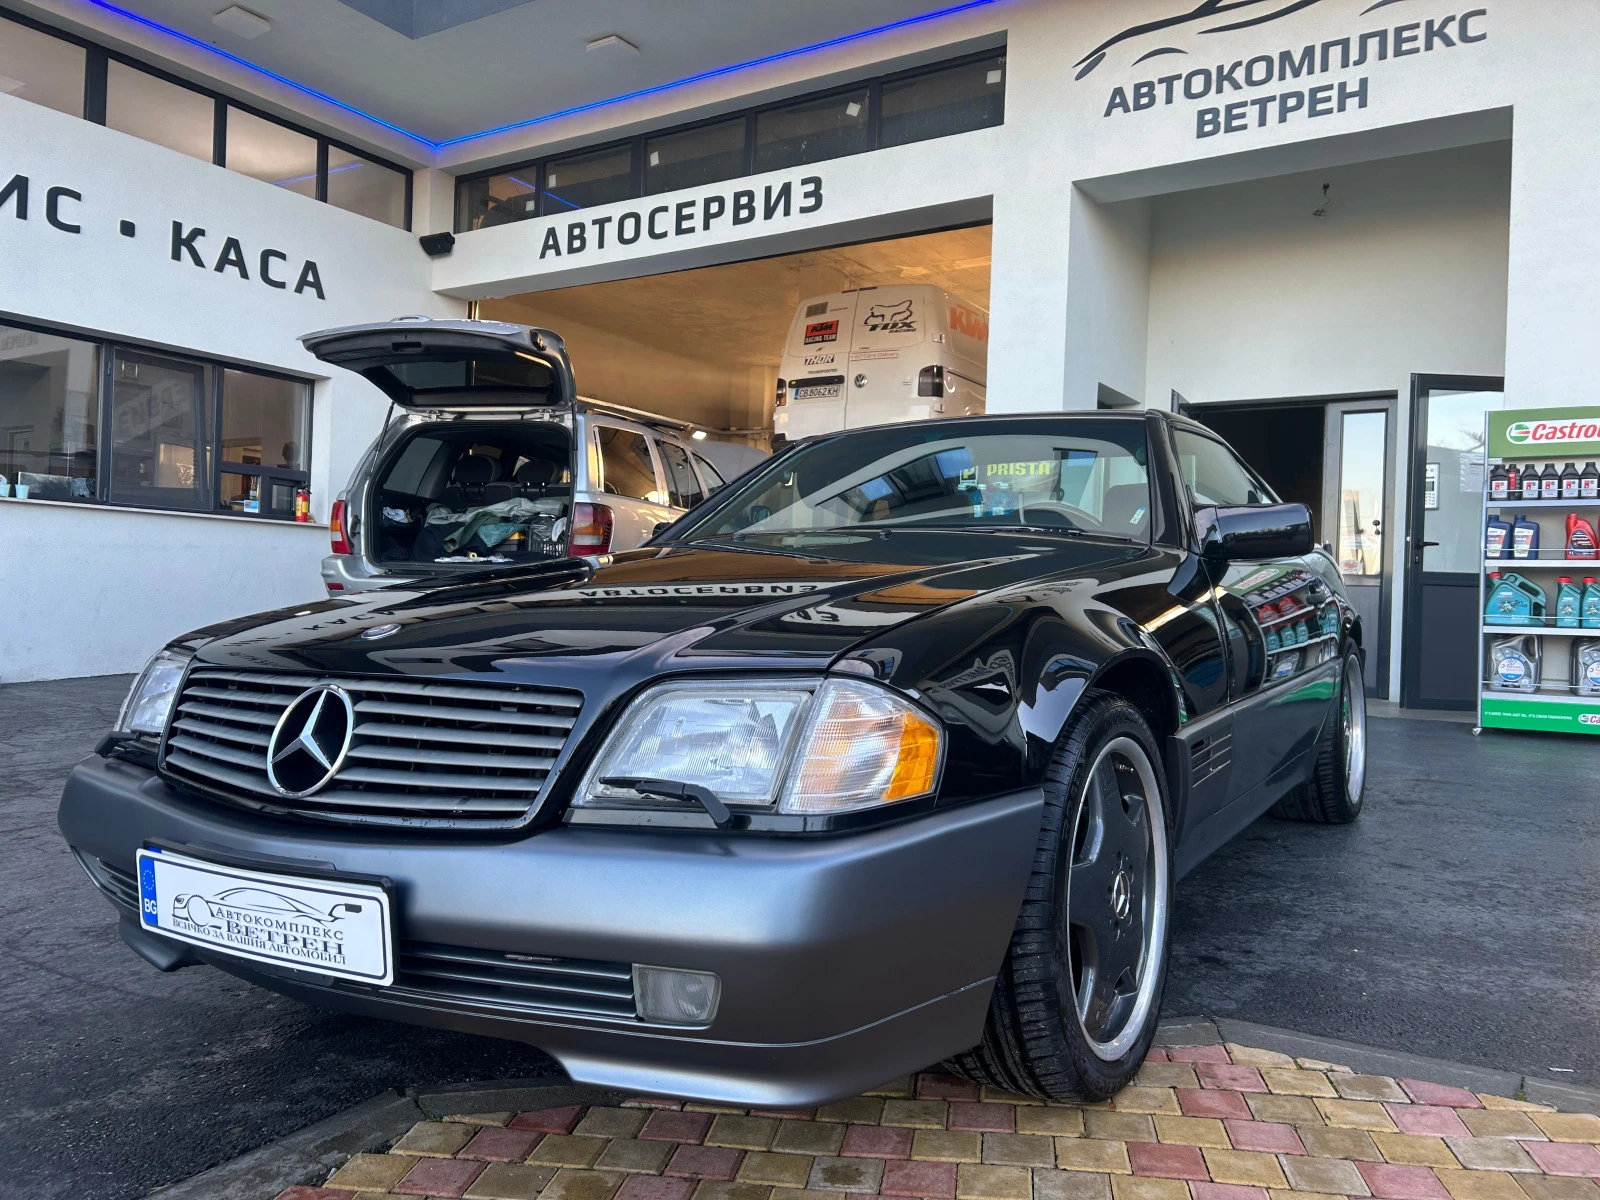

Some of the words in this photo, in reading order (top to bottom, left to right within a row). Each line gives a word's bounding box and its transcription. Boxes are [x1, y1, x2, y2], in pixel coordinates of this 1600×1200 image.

[1102, 8, 1487, 118] АВТОКОМПЛЕКС
[1196, 76, 1369, 139] ВЕТРЕН
[539, 175, 823, 259] АВТОСЕРВИЗ
[170, 220, 326, 300] КАСА
[805, 335, 823, 344] RACING
[810, 323, 834, 333] KTM
[869, 321, 917, 332] FOX
[805, 355, 834, 365] THOR
[986, 462, 1051, 476] PRISTA
[144, 898, 157, 915] BG
[216, 906, 344, 941] АВТОКОМПЛЕКС
[172, 917, 210, 935] ВСИЧКО
[212, 929, 225, 940] ЗА
[227, 933, 266, 950] ВАШИЯ
[268, 942, 346, 965] АВТОМОБИЛ
[226, 919, 345, 956] ВЕТРЕН
